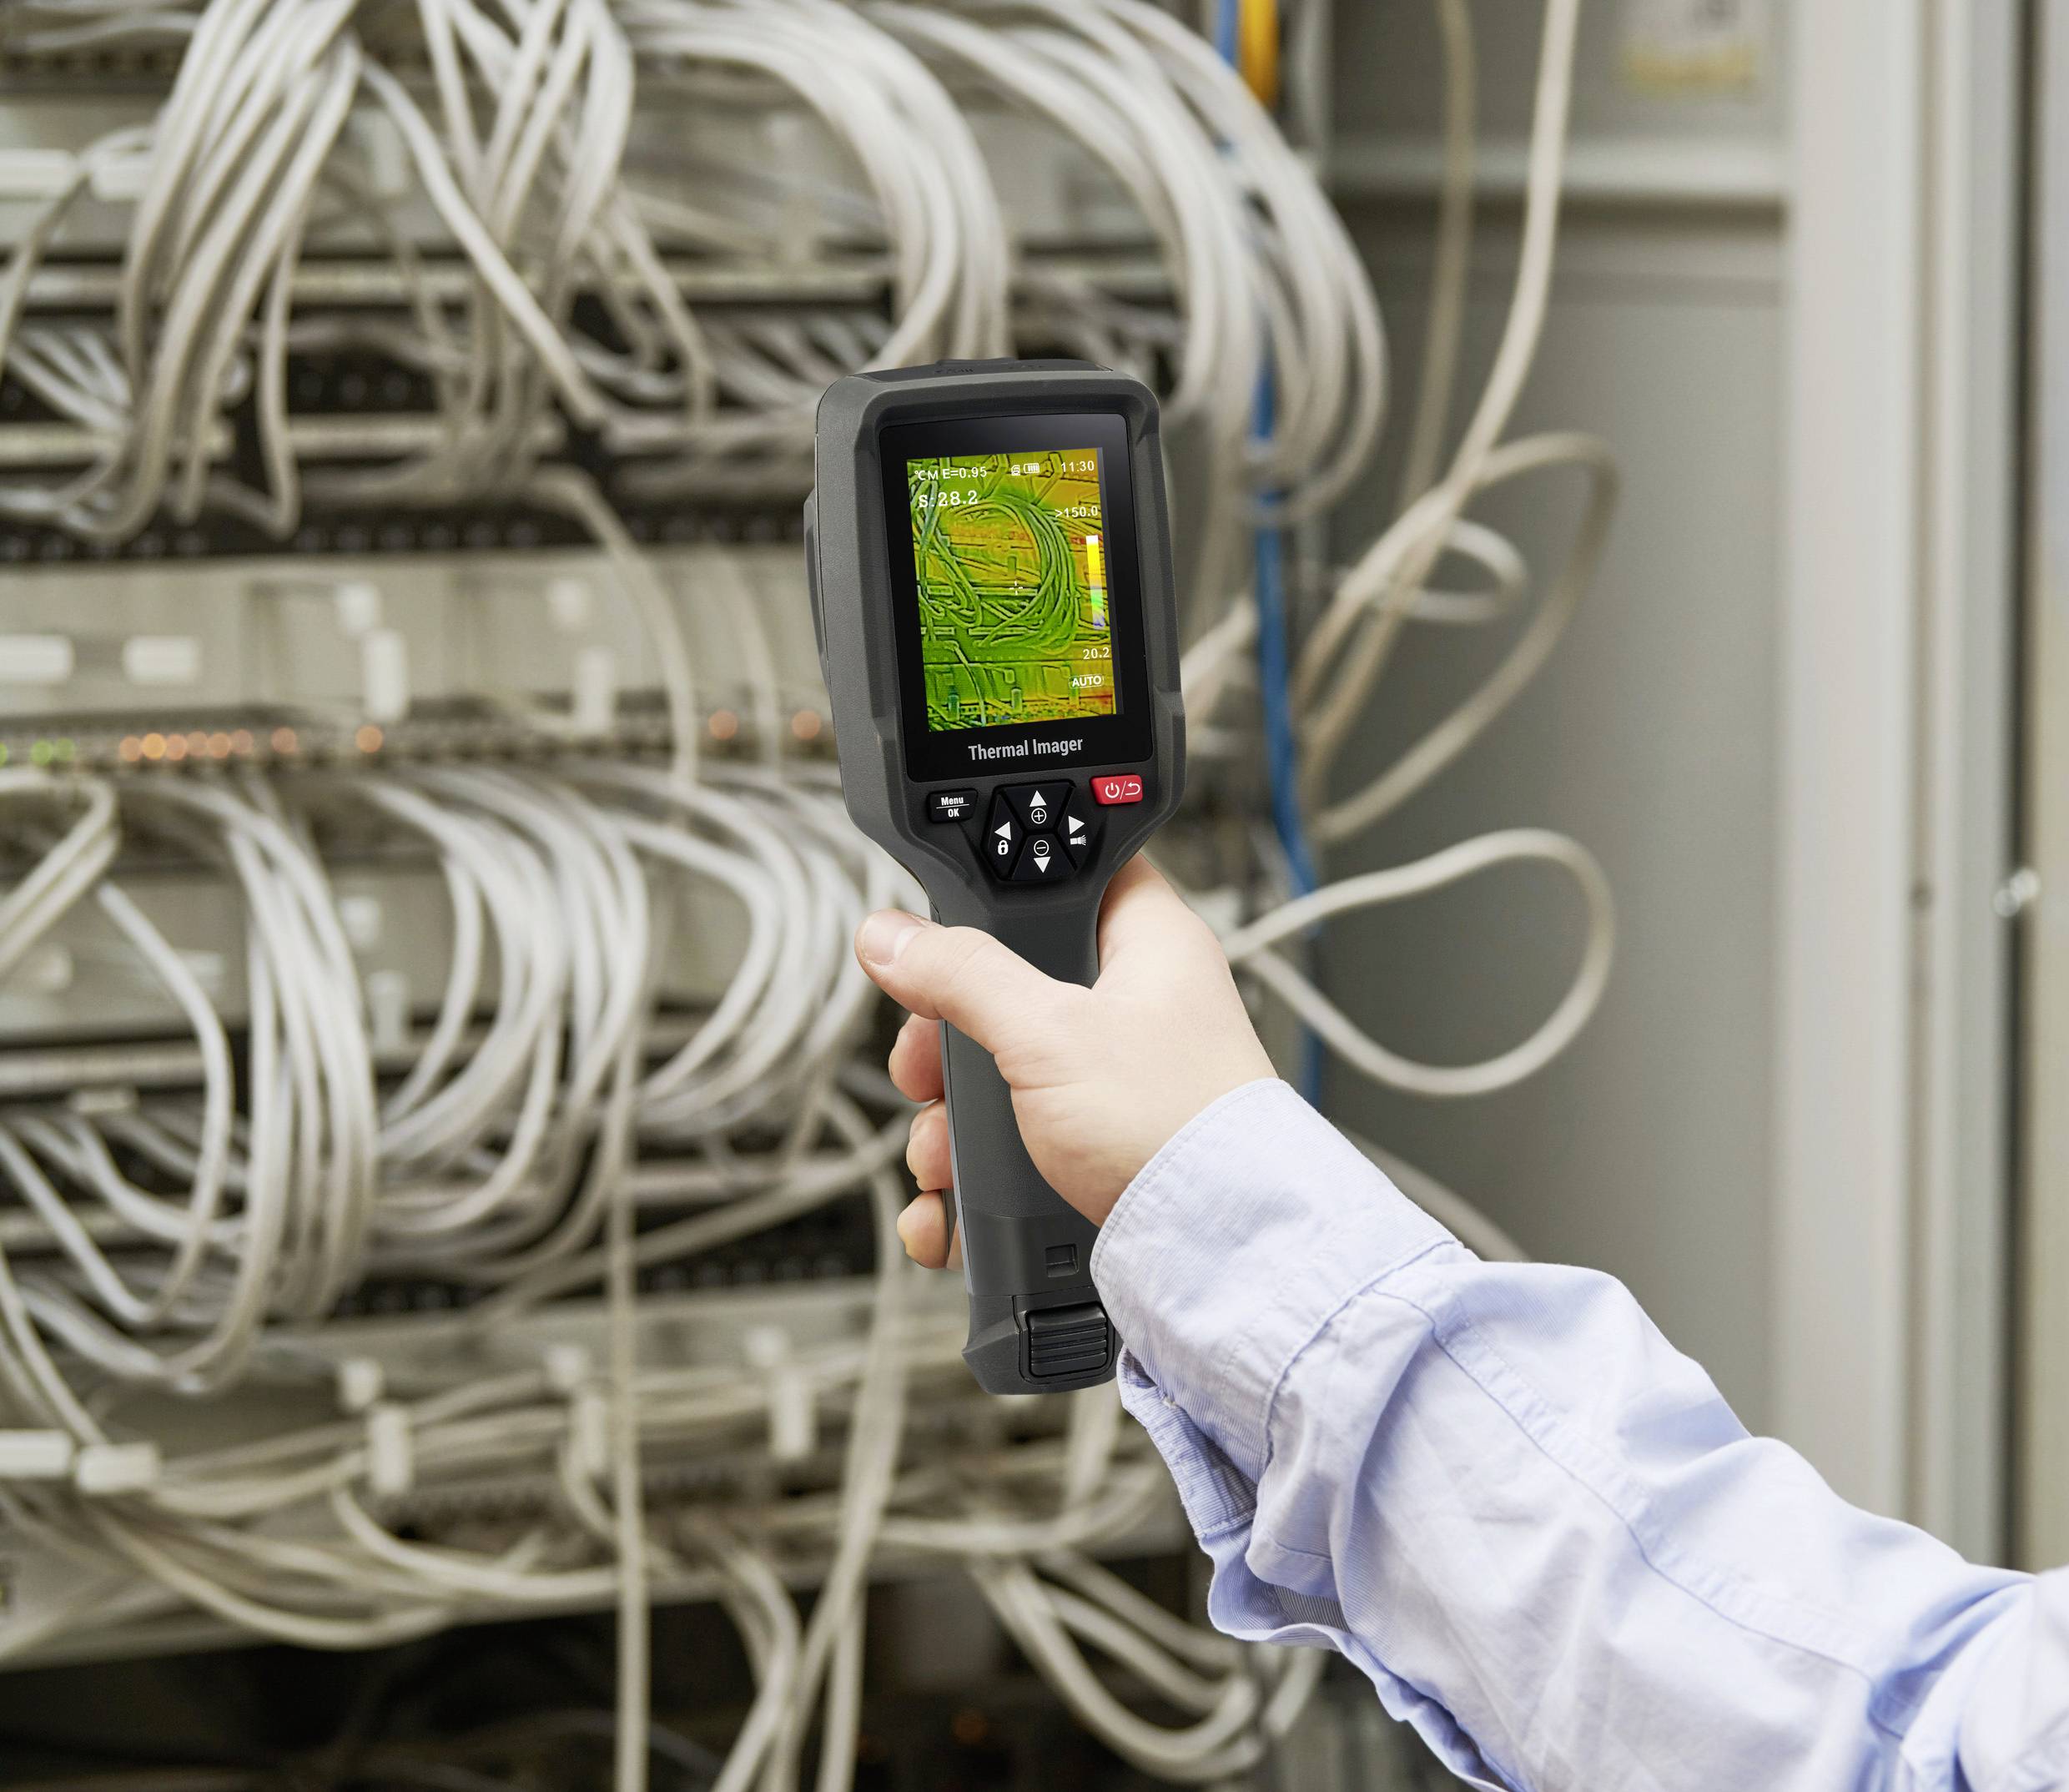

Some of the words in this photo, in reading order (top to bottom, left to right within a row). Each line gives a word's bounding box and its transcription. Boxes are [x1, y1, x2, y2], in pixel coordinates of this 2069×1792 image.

[1061, 460, 1095, 472] 11:30
[943, 466, 987, 480] E=0.95
[1055, 506, 1098, 518] >150.0
[1083, 647, 1110, 660] 20.2
[1072, 675, 1102, 687] AUTO
[968, 739, 1029, 761] Thermal
[1033, 738, 1084, 757] Imager
[941, 797, 964, 806] Menu
[948, 808, 959, 818] OK
